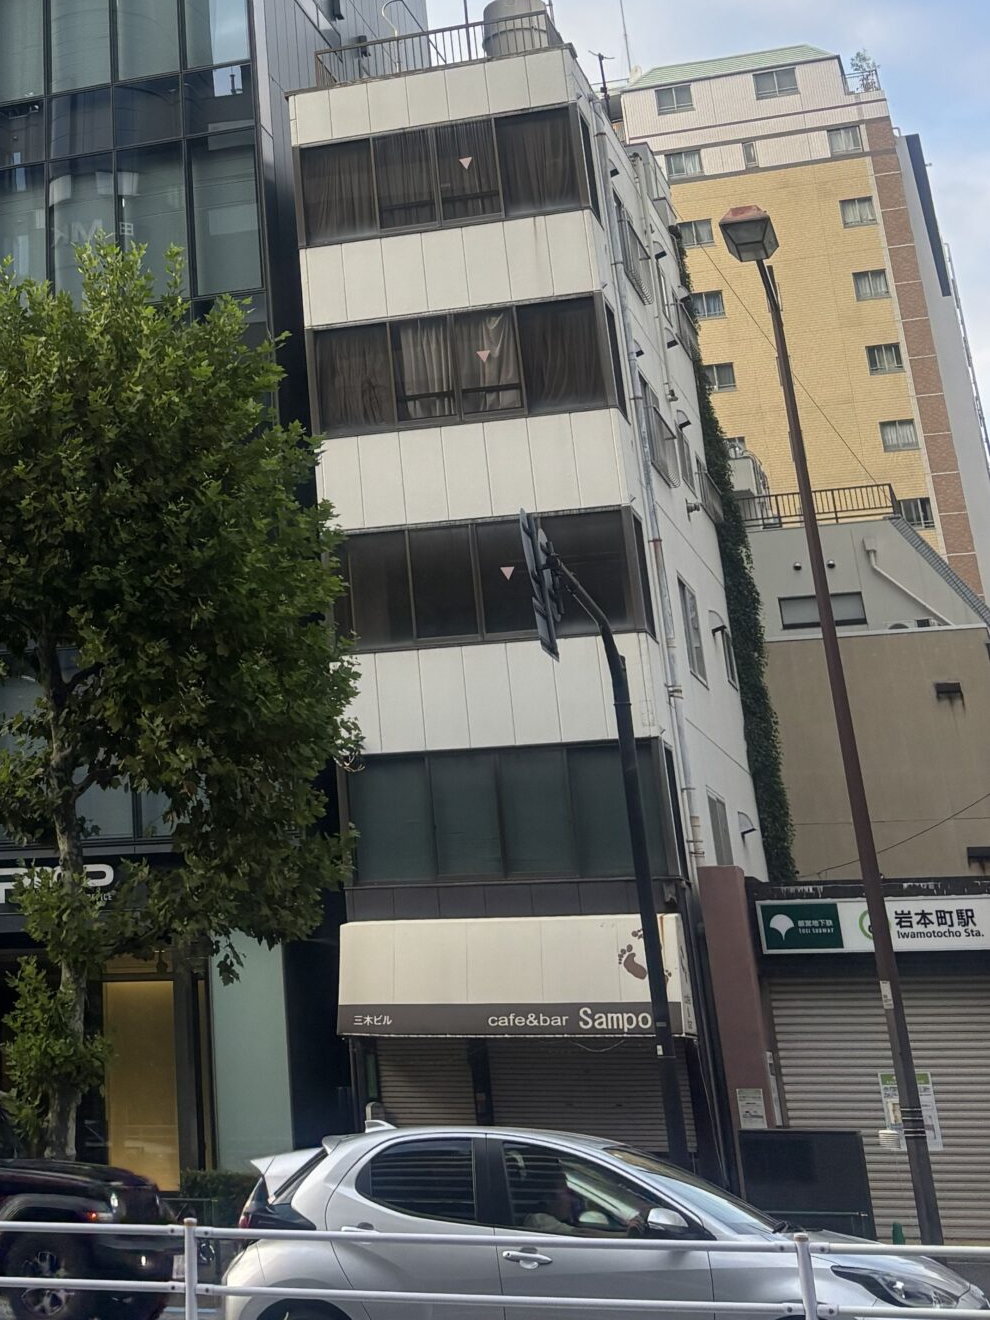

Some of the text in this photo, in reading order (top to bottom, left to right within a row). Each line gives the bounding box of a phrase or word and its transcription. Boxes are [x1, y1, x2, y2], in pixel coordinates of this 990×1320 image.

[894, 908, 977, 929] 岩本町駅
[897, 927, 985, 939] Iwamotocho Sta.
[353, 1014, 393, 1026] 三木ビル
[487, 1007, 652, 1032] cafe&bar Sampo
